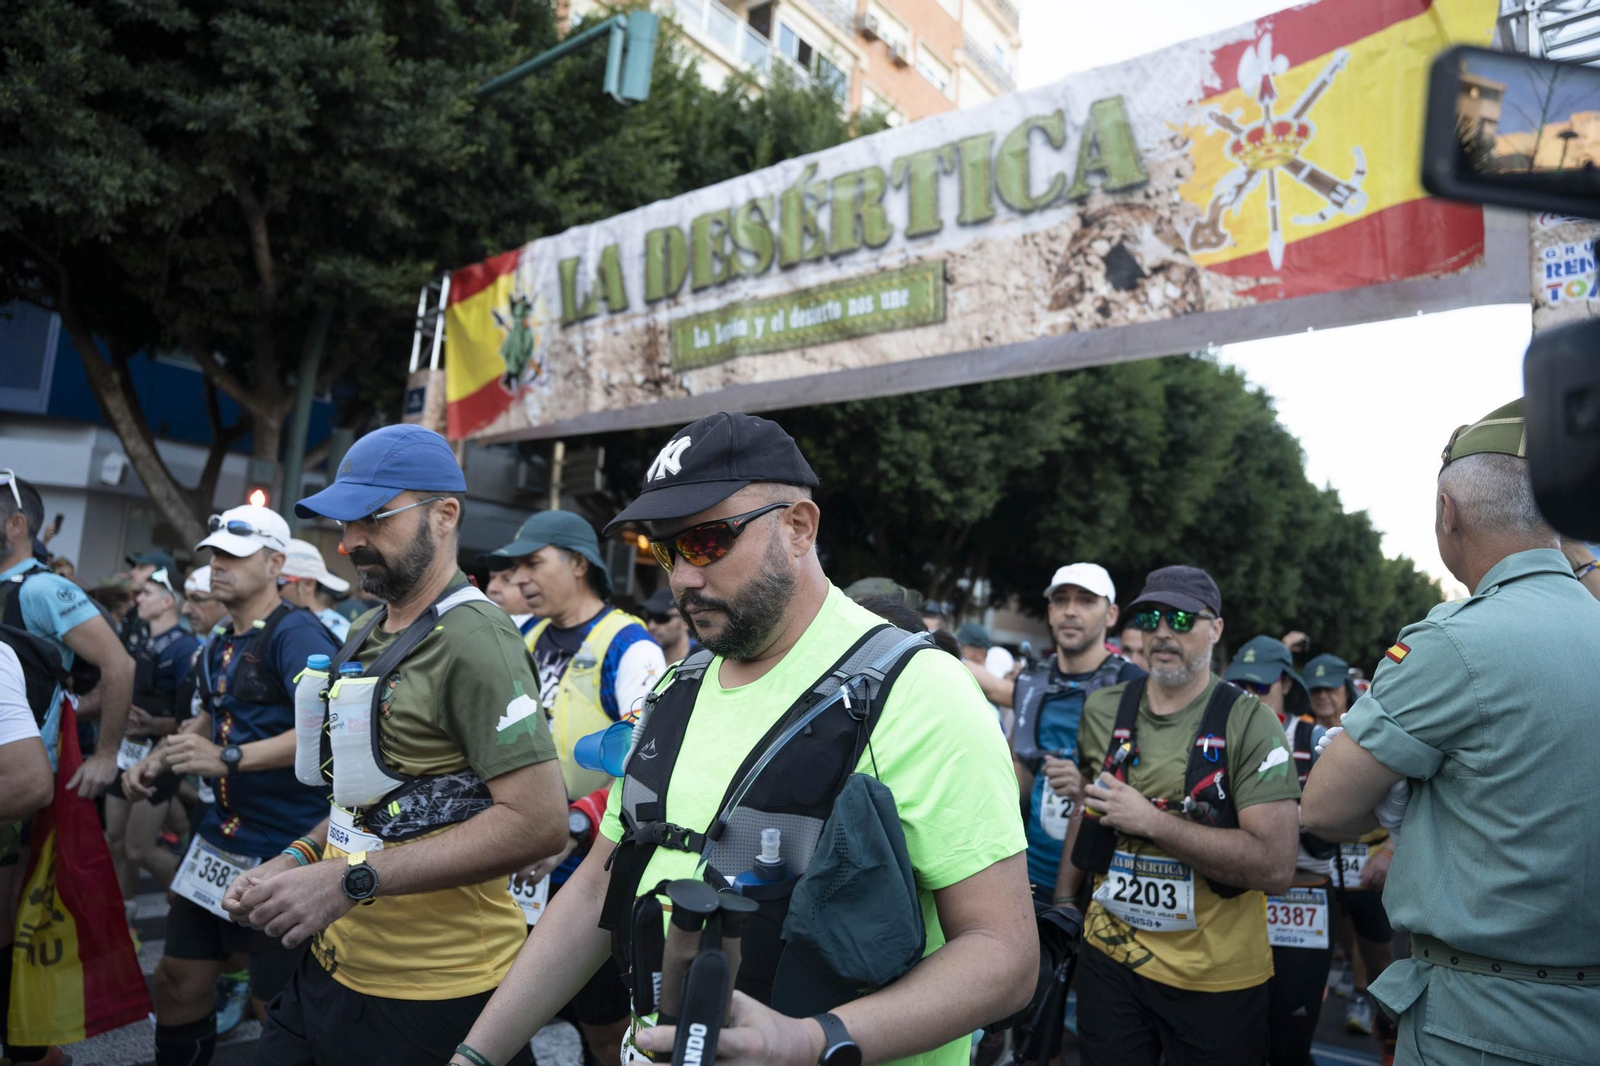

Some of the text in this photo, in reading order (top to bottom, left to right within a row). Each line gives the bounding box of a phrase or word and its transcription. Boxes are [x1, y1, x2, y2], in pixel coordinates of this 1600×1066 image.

[558, 94, 1149, 329] LA DESÉRTICA
[754, 316, 766, 338] y
[770, 307, 784, 332] el
[789, 300, 842, 329] desierto
[848, 294, 875, 317] nos
[880, 288, 910, 310] une
[1113, 876, 1177, 910] 2203
[1267, 905, 1317, 927] 3387
